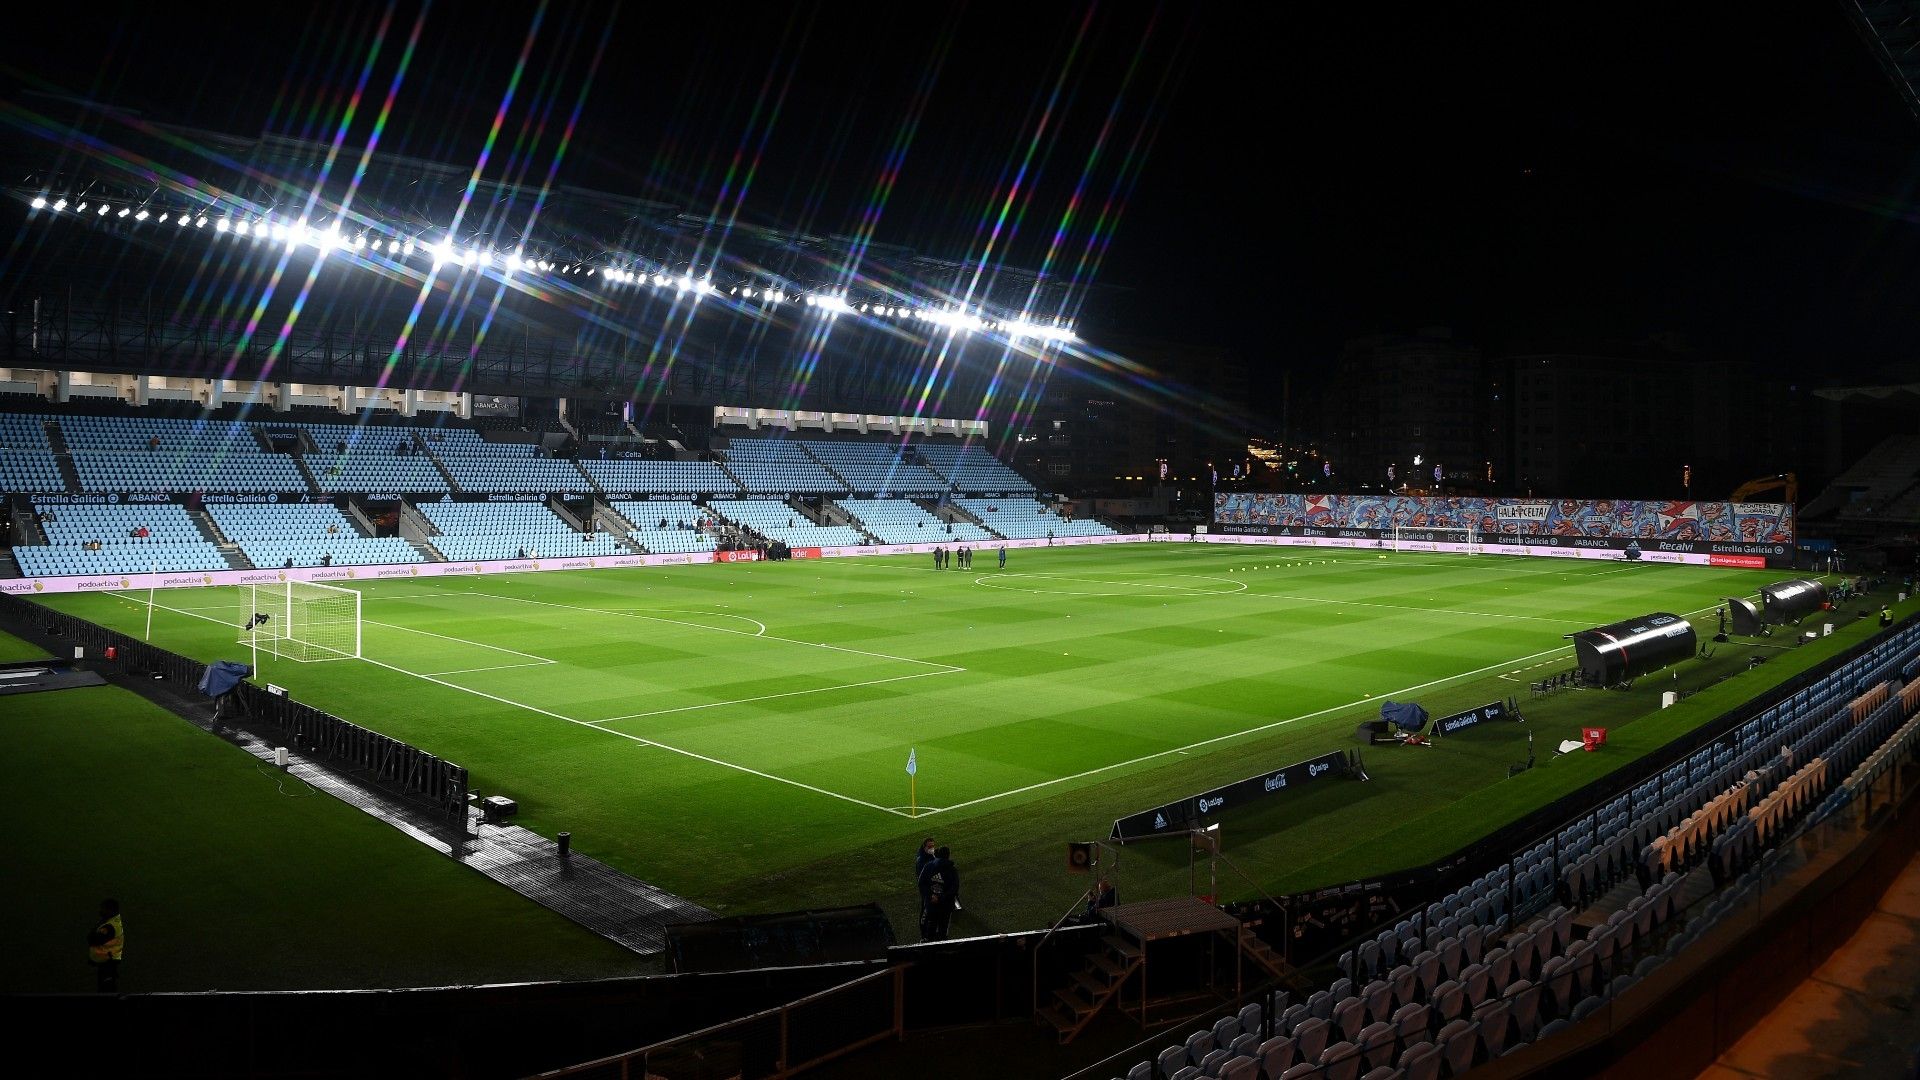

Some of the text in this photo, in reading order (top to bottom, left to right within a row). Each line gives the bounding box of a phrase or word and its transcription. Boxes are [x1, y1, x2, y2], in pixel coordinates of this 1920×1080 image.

[30, 493, 106, 504] Estrella Galicia
[131, 493, 171, 502] ABANCA
[201, 493, 266, 503] Estrella Galicia
[368, 493, 402, 501] ABANCA
[488, 493, 538, 502] Estrella Galicia
[1499, 506, 1547, 518] HALA CELTA!
[1524, 537, 1549, 545] Galicia
[1575, 538, 1609, 547] ABANCA
[1659, 541, 1694, 552] Recalvi
[1712, 544, 1773, 554] Estrella Galicia
[163, 576, 202, 586] podoactiva
[240, 574, 277, 583] podoactiva
[78, 580, 119, 590] podoactiva
